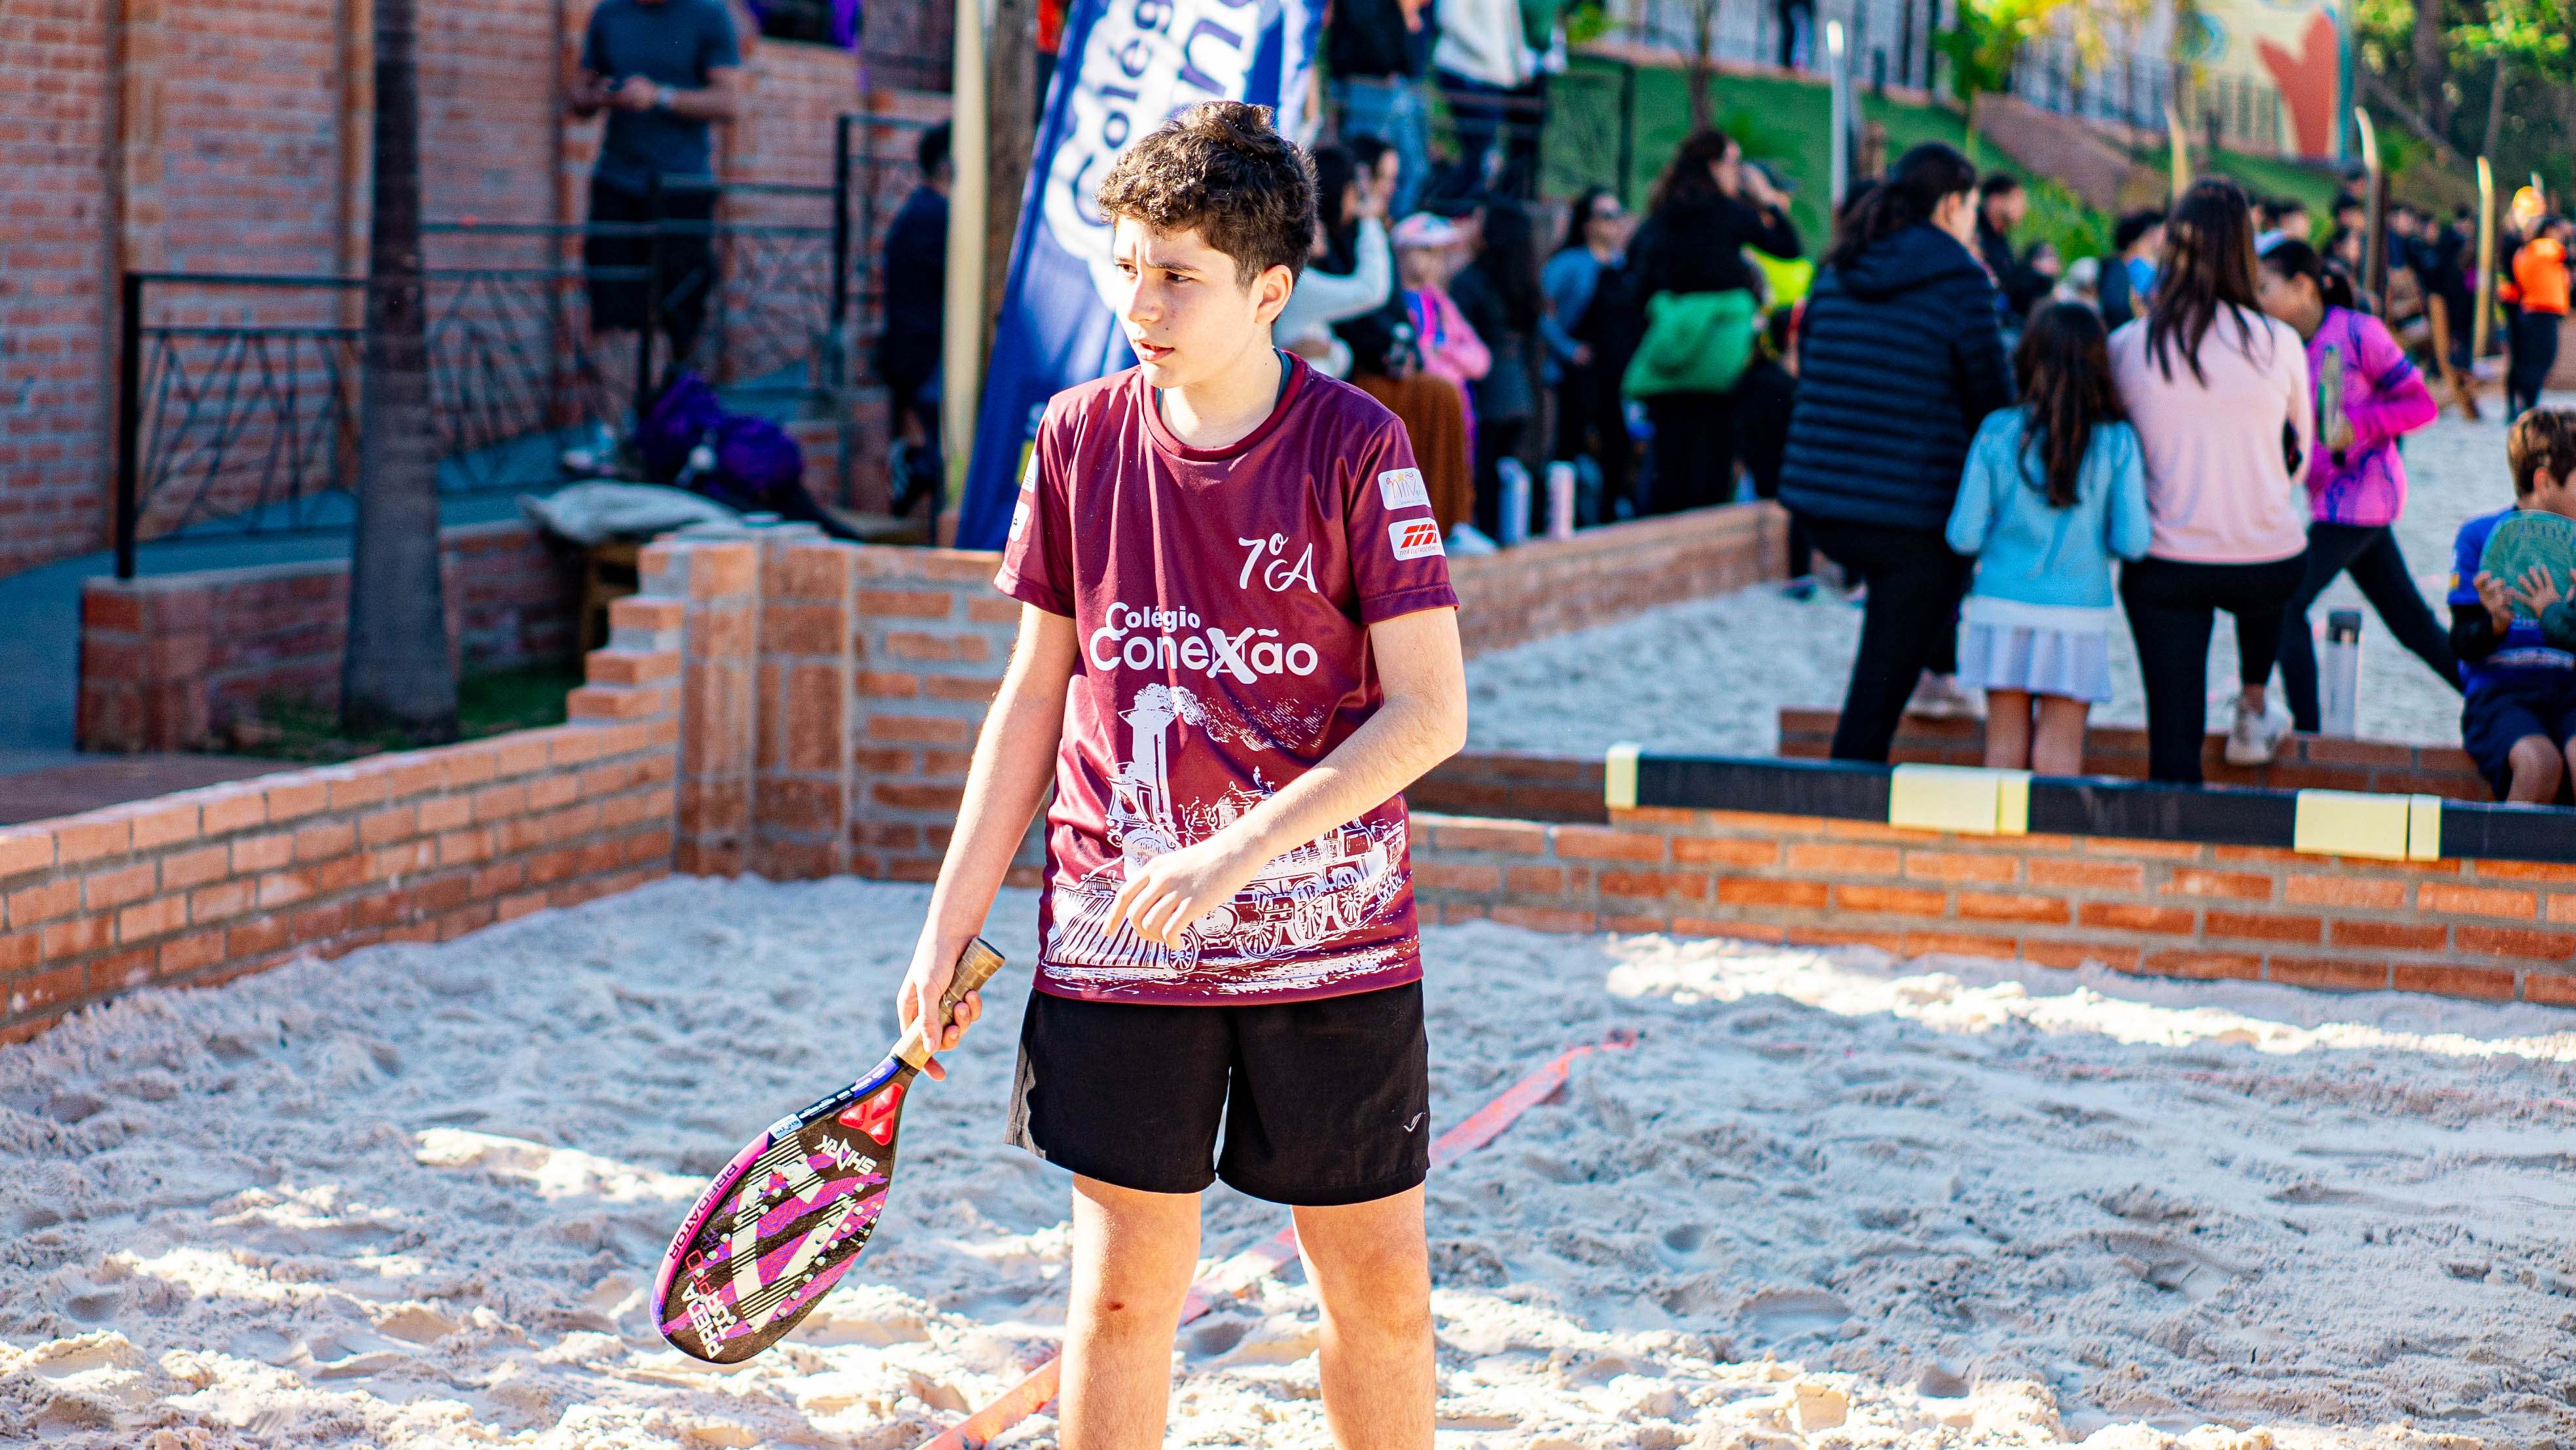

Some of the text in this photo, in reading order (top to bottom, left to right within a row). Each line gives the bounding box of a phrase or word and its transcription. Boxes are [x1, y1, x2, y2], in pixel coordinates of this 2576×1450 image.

[1105, 601, 1201, 637] Colégio
[669, 1163, 739, 1260] PREDATOR
[681, 1281, 725, 1360] PREDA
